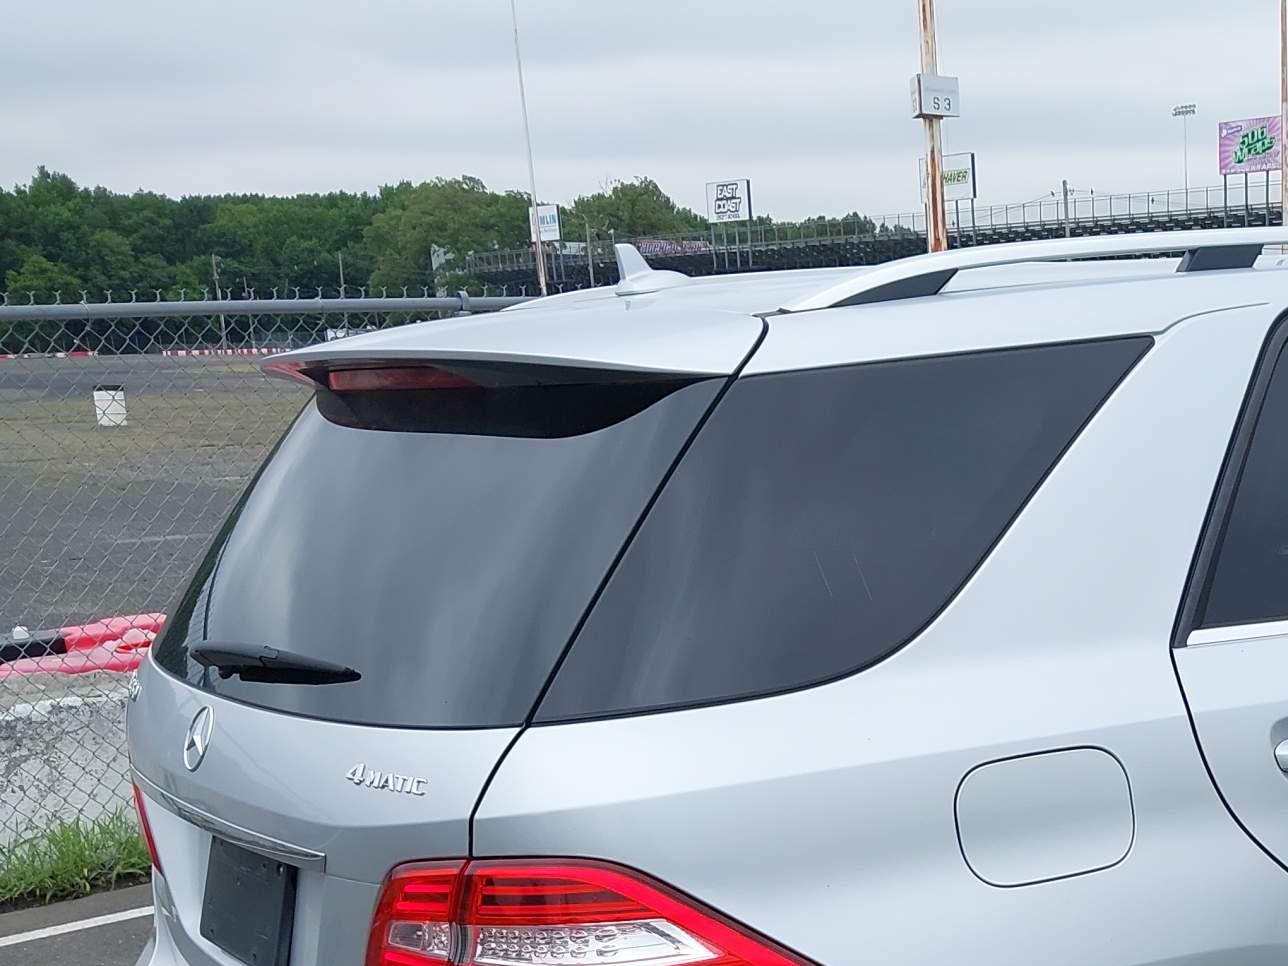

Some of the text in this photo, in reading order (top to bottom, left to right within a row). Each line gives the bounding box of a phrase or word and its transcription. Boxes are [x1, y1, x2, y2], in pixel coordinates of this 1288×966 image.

[932, 96, 940, 111] S
[944, 97, 952, 111] 3
[716, 182, 738, 199] EAST
[715, 197, 742, 214] COAST
